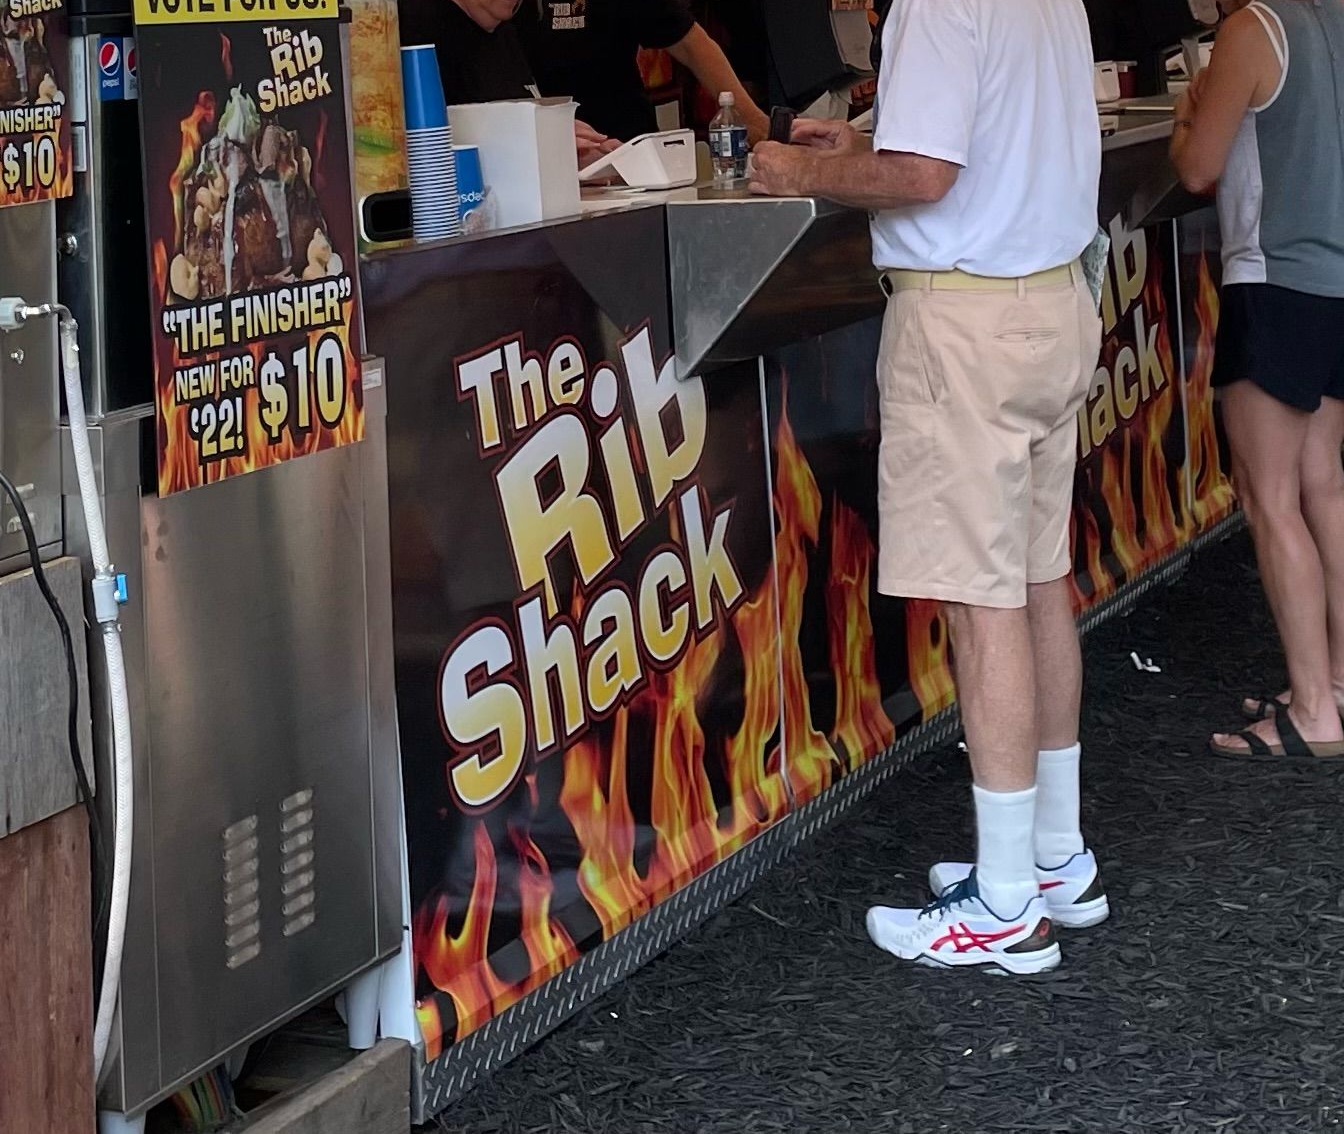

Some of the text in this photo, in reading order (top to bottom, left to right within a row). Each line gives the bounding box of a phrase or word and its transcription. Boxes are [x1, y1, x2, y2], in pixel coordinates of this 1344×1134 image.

[262, 26, 293, 48] The
[269, 29, 324, 81] Rib
[257, 66, 333, 114] Shack
[2, 136, 57, 192] $10
[162, 277, 352, 354] "THE FINISHER"
[175, 353, 256, 402] NEW FOR
[259, 337, 346, 439] $10
[459, 338, 584, 449] The
[1076, 303, 1166, 460] ack
[190, 396, 245, 458] '22!
[495, 331, 707, 592] Rib
[439, 486, 744, 810] Shack
